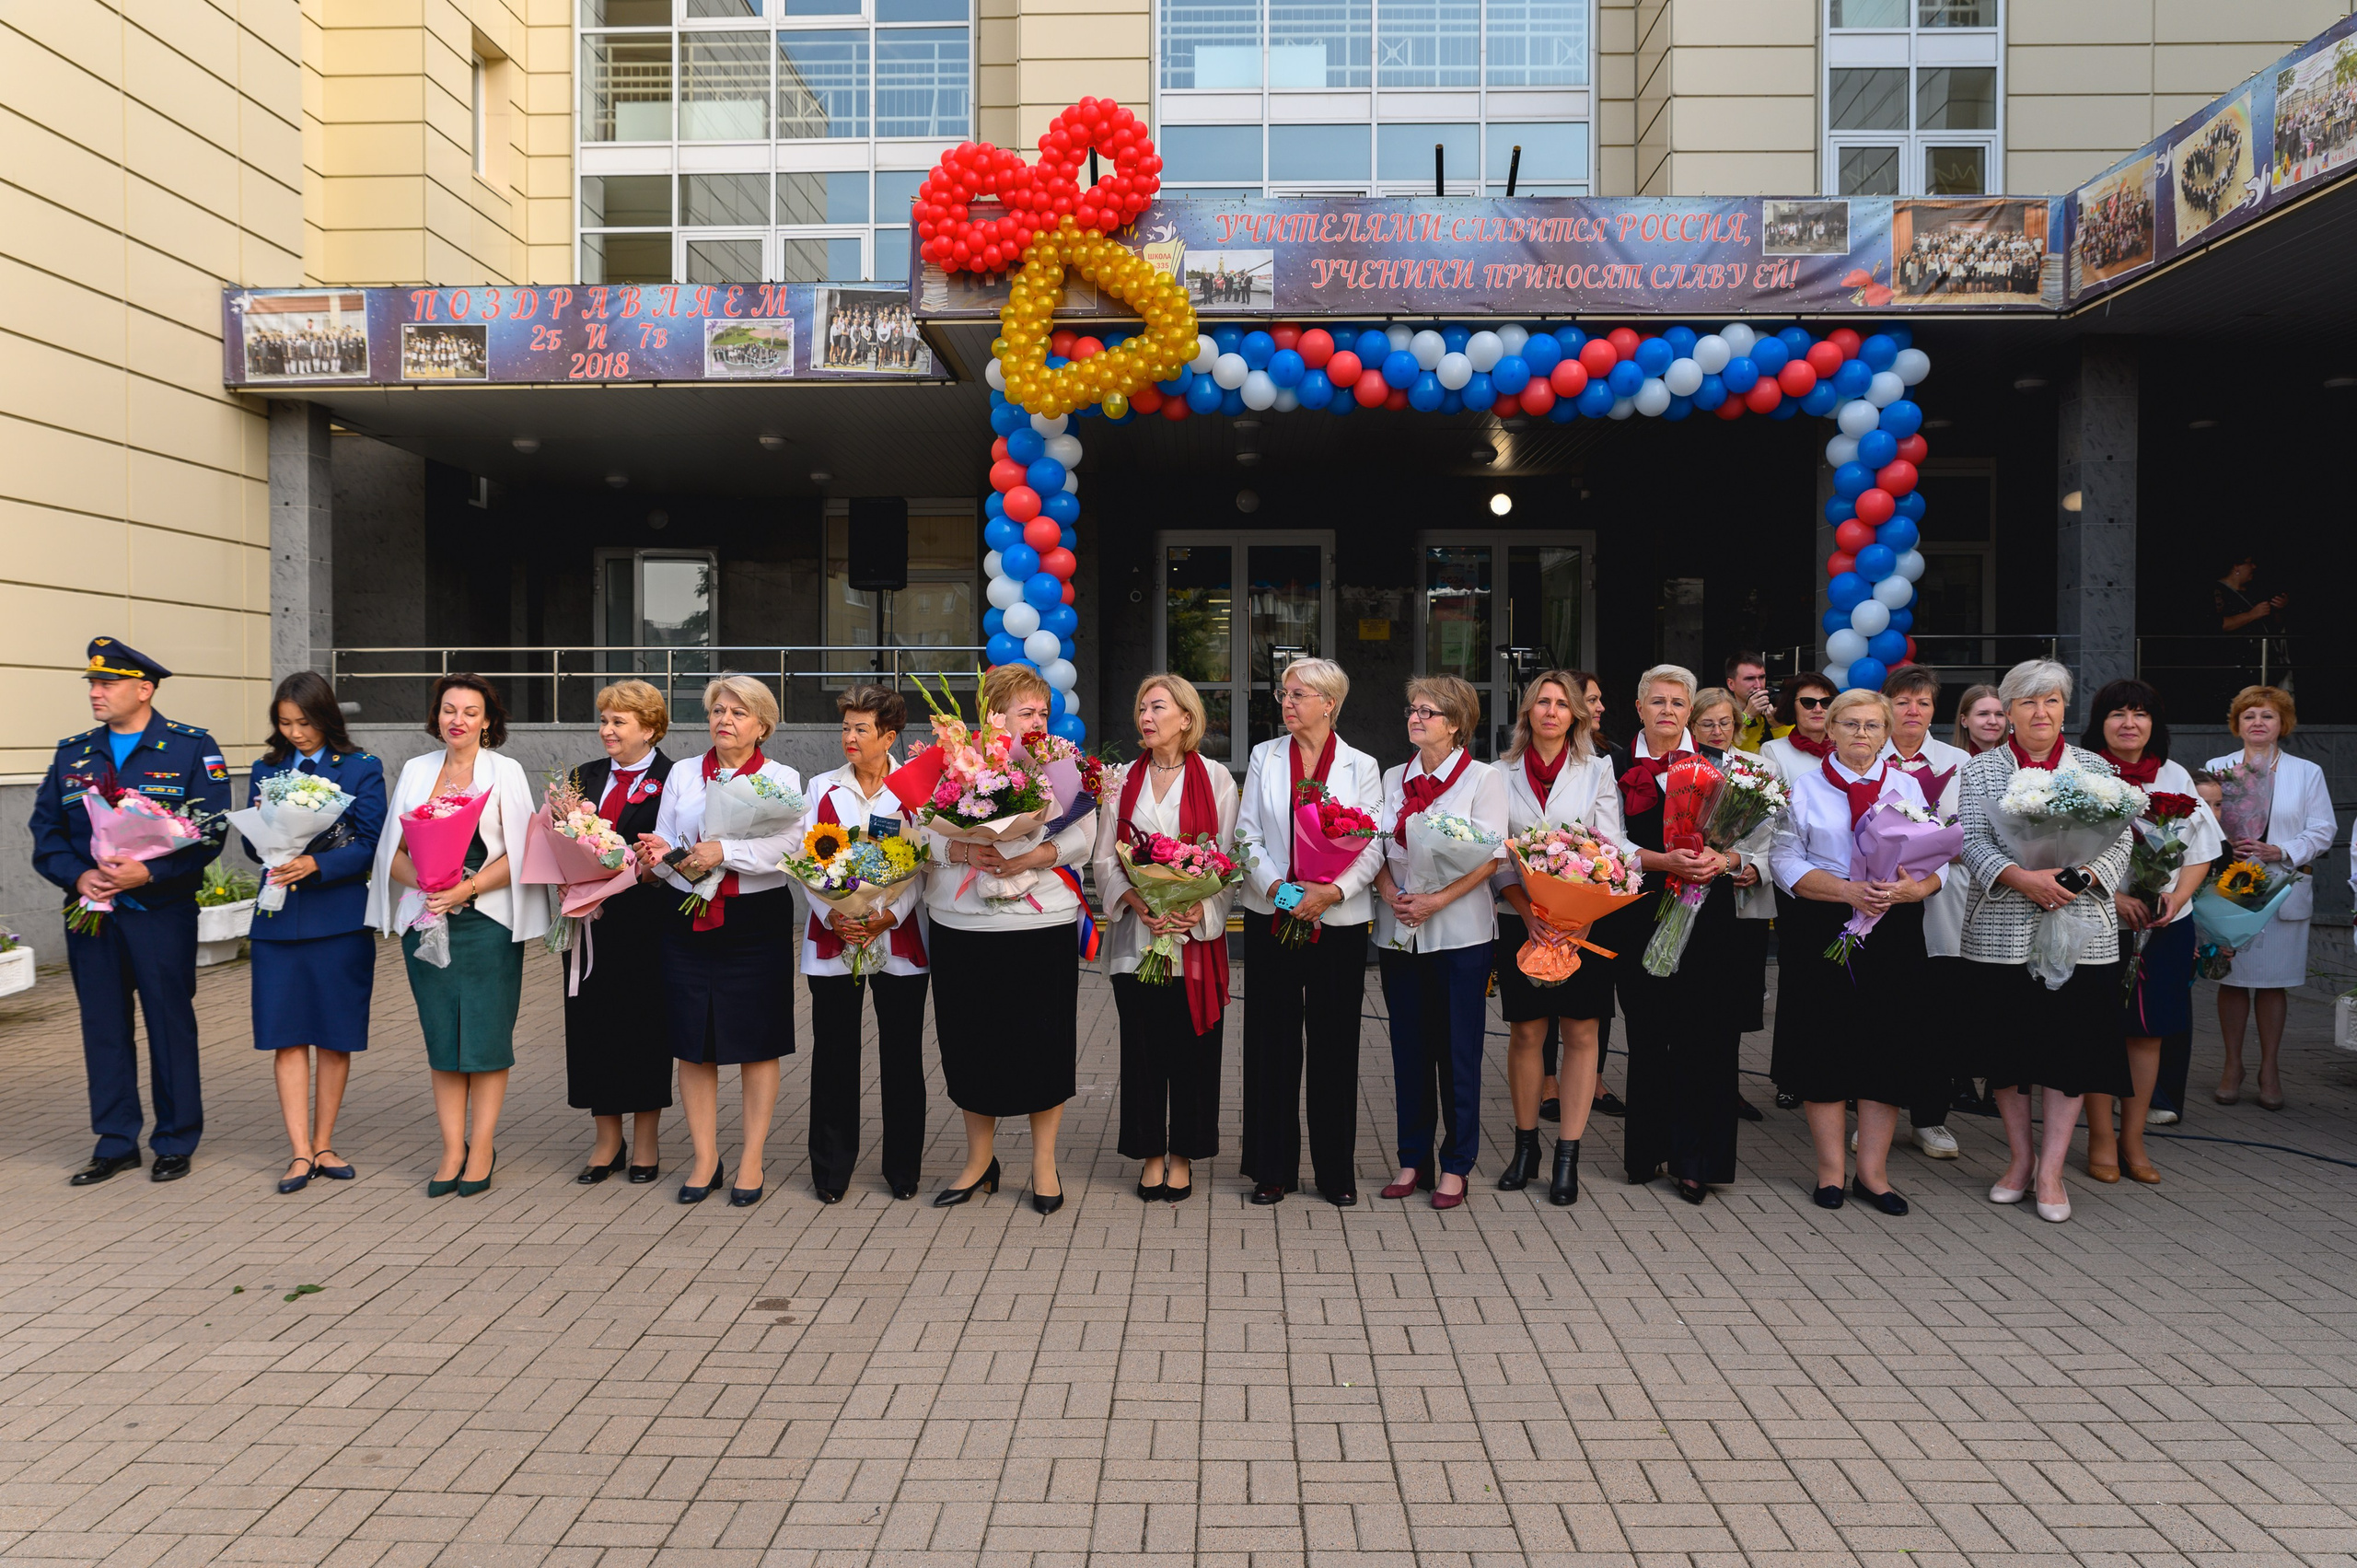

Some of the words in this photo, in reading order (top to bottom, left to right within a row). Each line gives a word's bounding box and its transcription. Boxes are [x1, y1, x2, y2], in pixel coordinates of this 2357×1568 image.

[1215, 213, 1442, 243] УЧИТЕЛЯМИ
[1451, 216, 1610, 242] СЛАВИТСЯ
[1615, 213, 1751, 246] РОССИЯ,
[1310, 258, 1475, 289] УЧЕНИКИ
[1482, 263, 1643, 289] ПРИНОСЯТ
[1650, 263, 1747, 289] СЛАВУ
[1752, 258, 1801, 289] ЕЙ!
[411, 284, 790, 321] ПОЗДРАВЛЯЕМ
[585, 323, 608, 350] И
[567, 352, 630, 378] 2018
